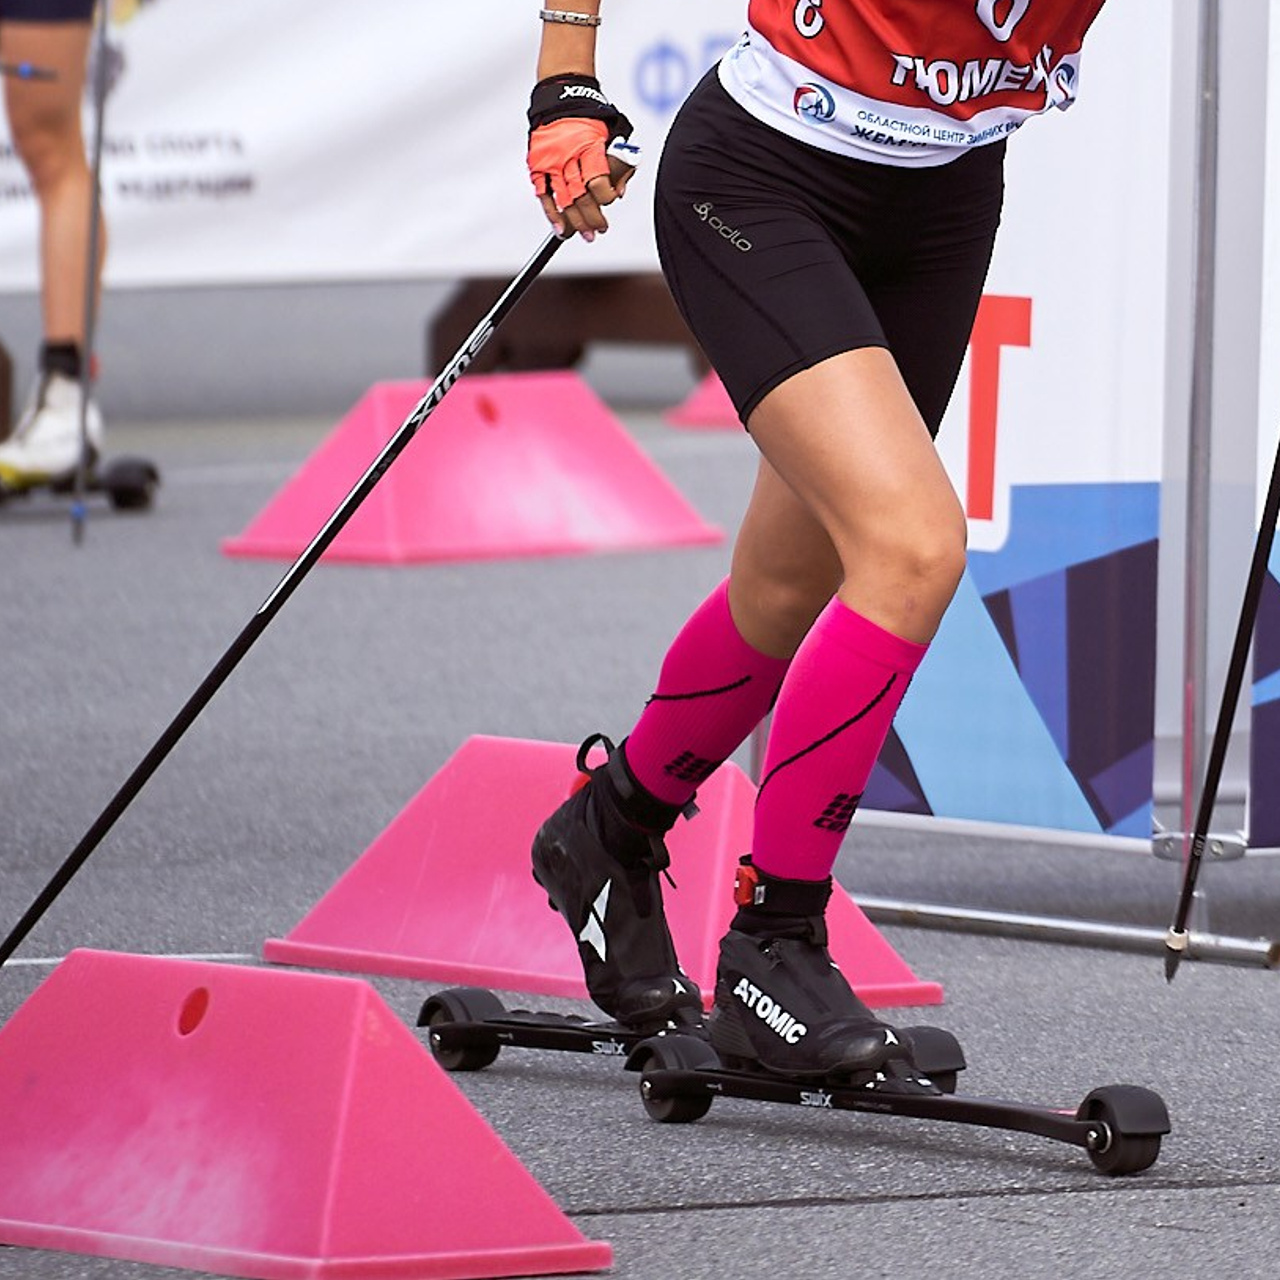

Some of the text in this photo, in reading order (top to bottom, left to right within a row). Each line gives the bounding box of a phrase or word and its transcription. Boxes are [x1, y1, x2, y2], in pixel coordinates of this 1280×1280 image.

[857, 109, 931, 138] ОБЛАСТНОЙ
[933, 126, 965, 144] ЦЕНТР
[733, 977, 808, 1045] ATOMIC
